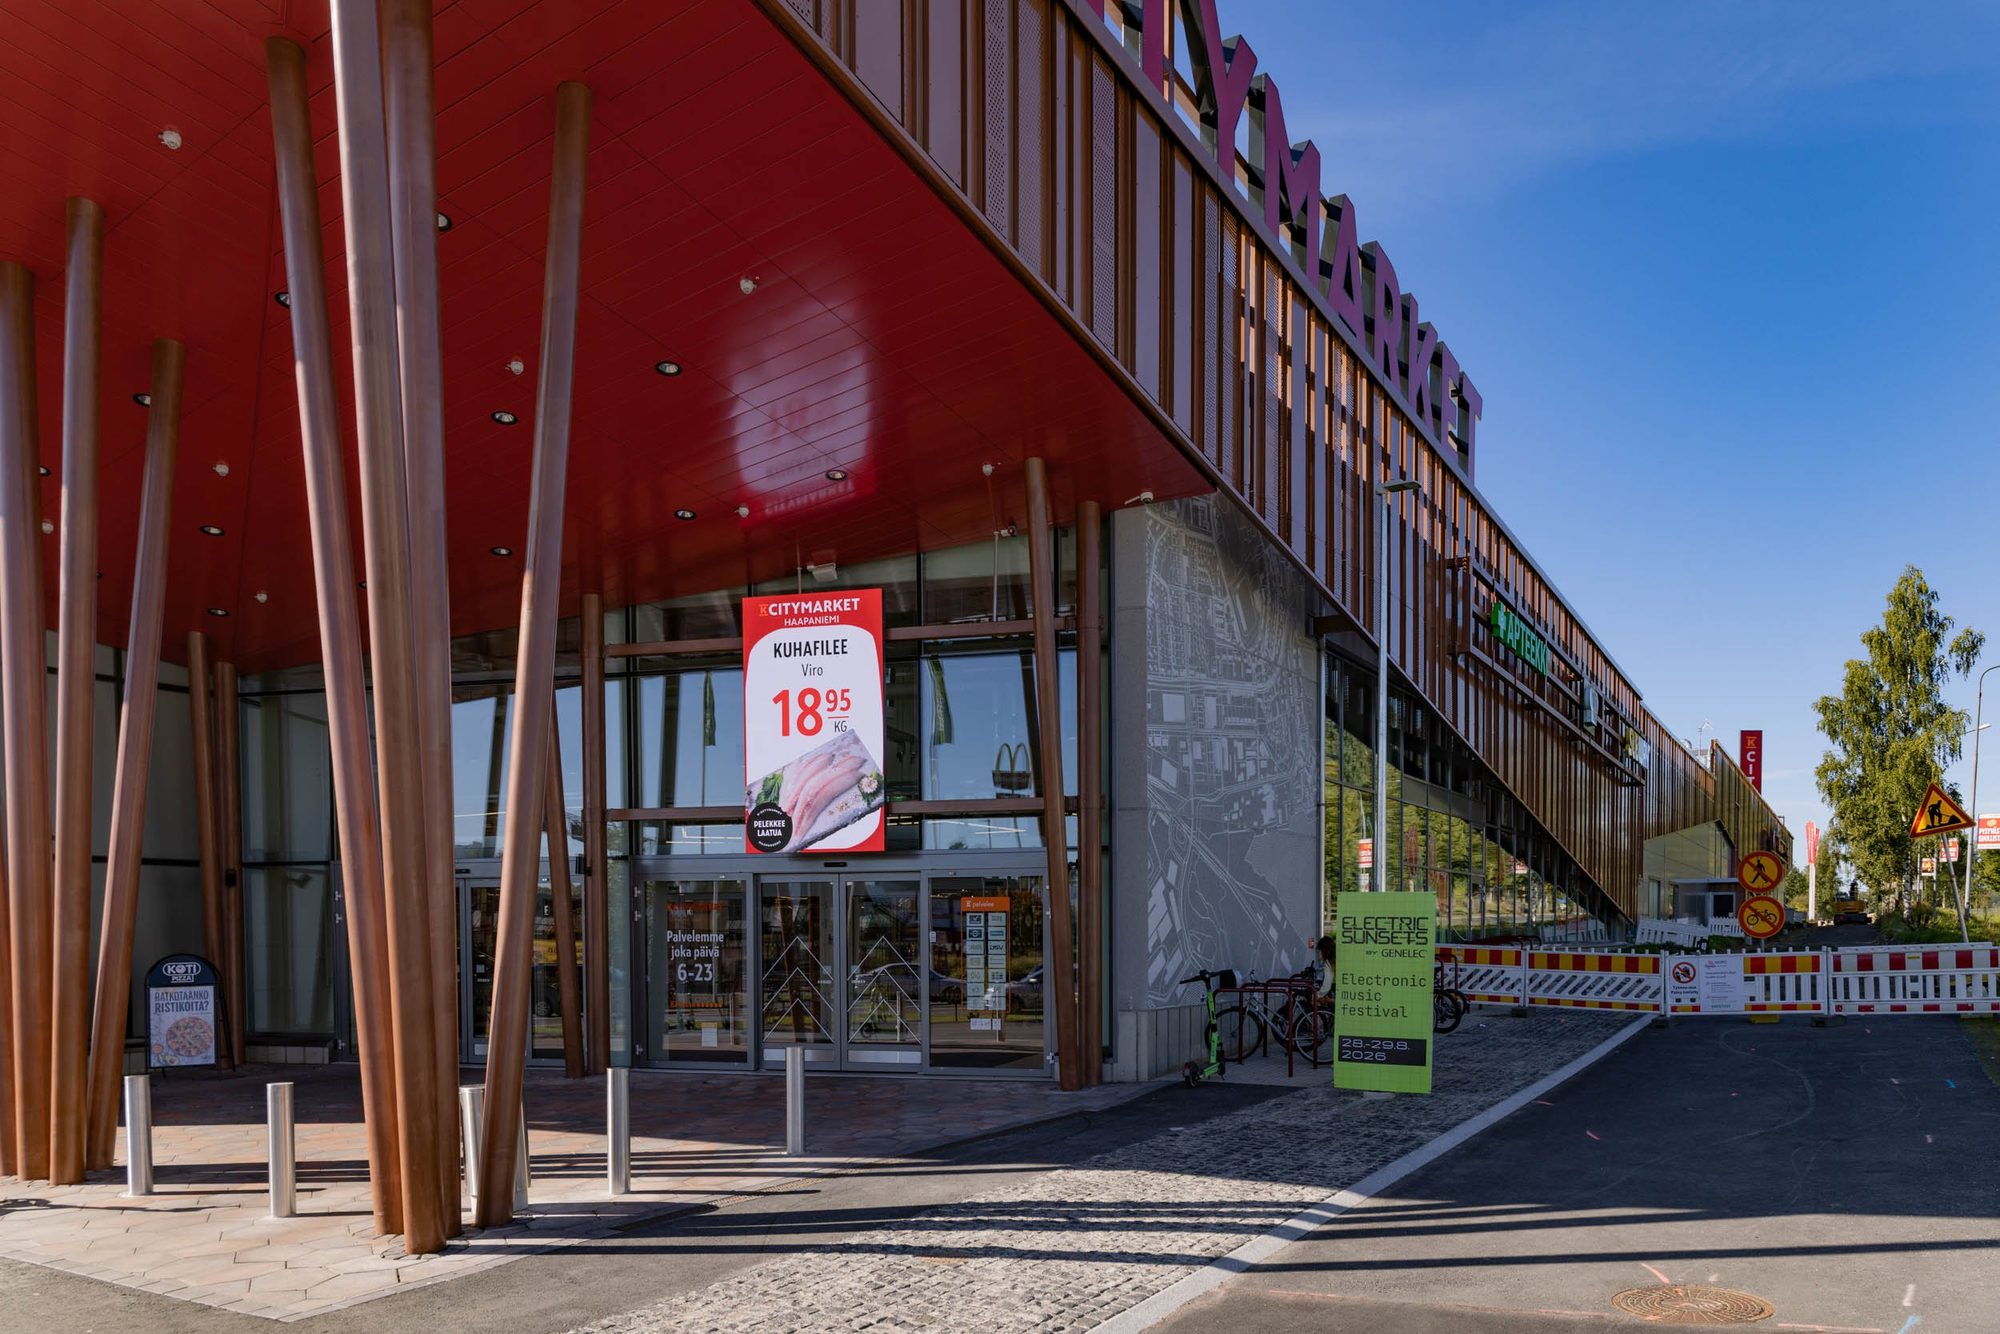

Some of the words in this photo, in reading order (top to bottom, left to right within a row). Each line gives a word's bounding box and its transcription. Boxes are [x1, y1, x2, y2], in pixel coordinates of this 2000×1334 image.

[1088, 0, 1483, 486] YMARKET
[768, 598, 860, 616] CITYMARKET
[784, 615, 840, 627] HAAPANIEMI
[773, 639, 848, 658] KUHAFILEE
[1506, 612, 1549, 676] APTEEKKI
[801, 663, 824, 677] Viro
[834, 721, 848, 733] KG
[753, 820, 786, 828] PELEKKEE
[757, 829, 782, 837] LAATUA
[1341, 916, 1429, 931] ELECTRIC
[666, 929, 724, 942] Palvelemme
[1341, 930, 1429, 945] SUNSETS
[671, 945, 692, 961] joka
[694, 946, 720, 960] päivä
[1381, 948, 1425, 958] GENELEC
[167, 964, 197, 974] KOTI
[677, 963, 713, 981] 6-23
[1341, 973, 1427, 987] Electronic
[1341, 988, 1382, 1002] music
[154, 1000, 209, 1013] RISTIKOITA?
[1341, 1004, 1408, 1018] festival
[1341, 1038, 1410, 1051] 28.-29.8.
[1341, 1049, 1386, 1061] 2026
